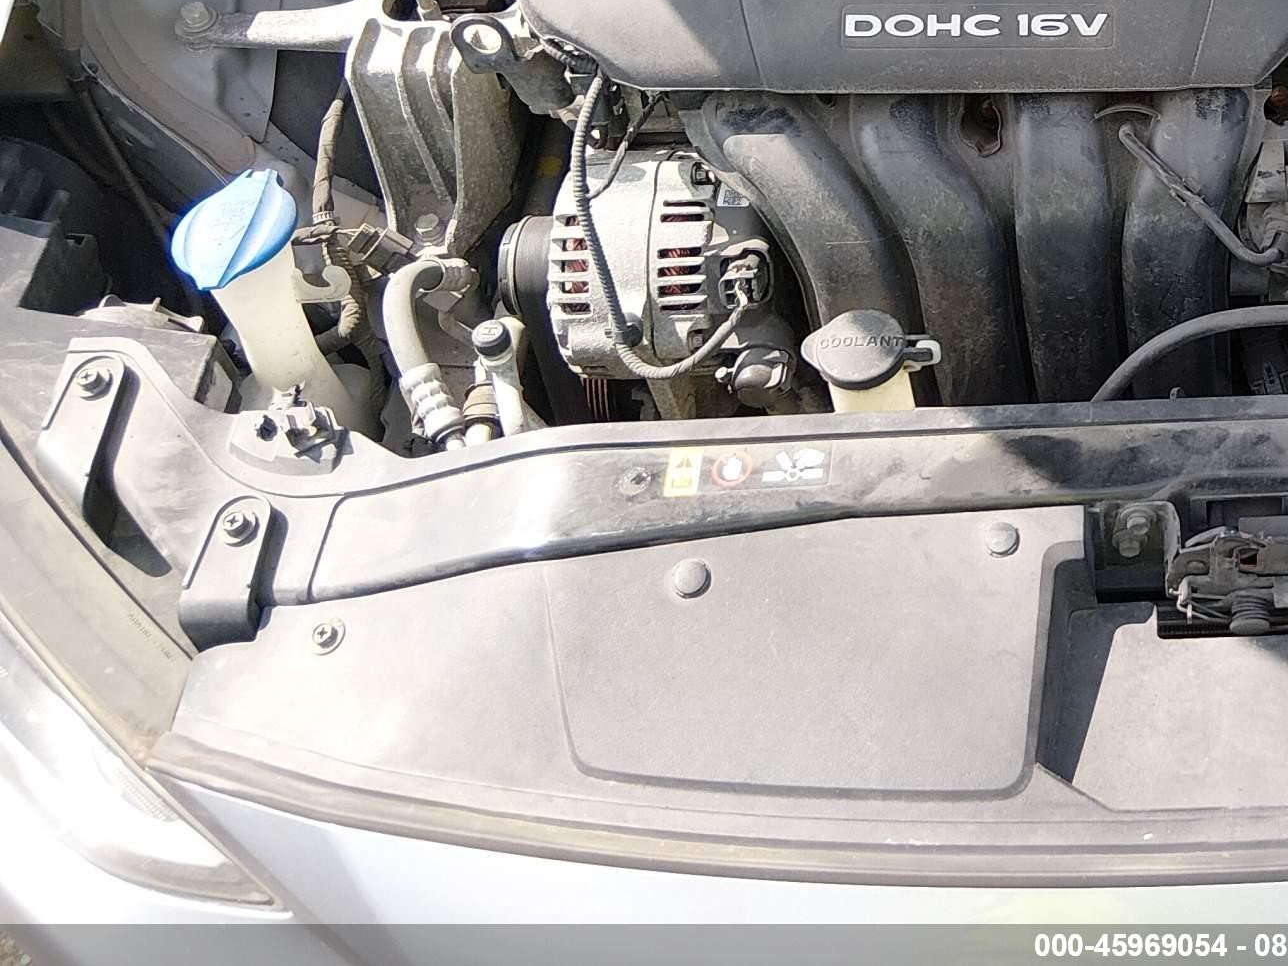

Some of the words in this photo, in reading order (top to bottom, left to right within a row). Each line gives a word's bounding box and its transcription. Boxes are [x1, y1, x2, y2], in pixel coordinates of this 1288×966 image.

[845, 14, 1001, 37] DOHC
[1017, 13, 1108, 37] 16V
[820, 336, 904, 348] COOLANT
